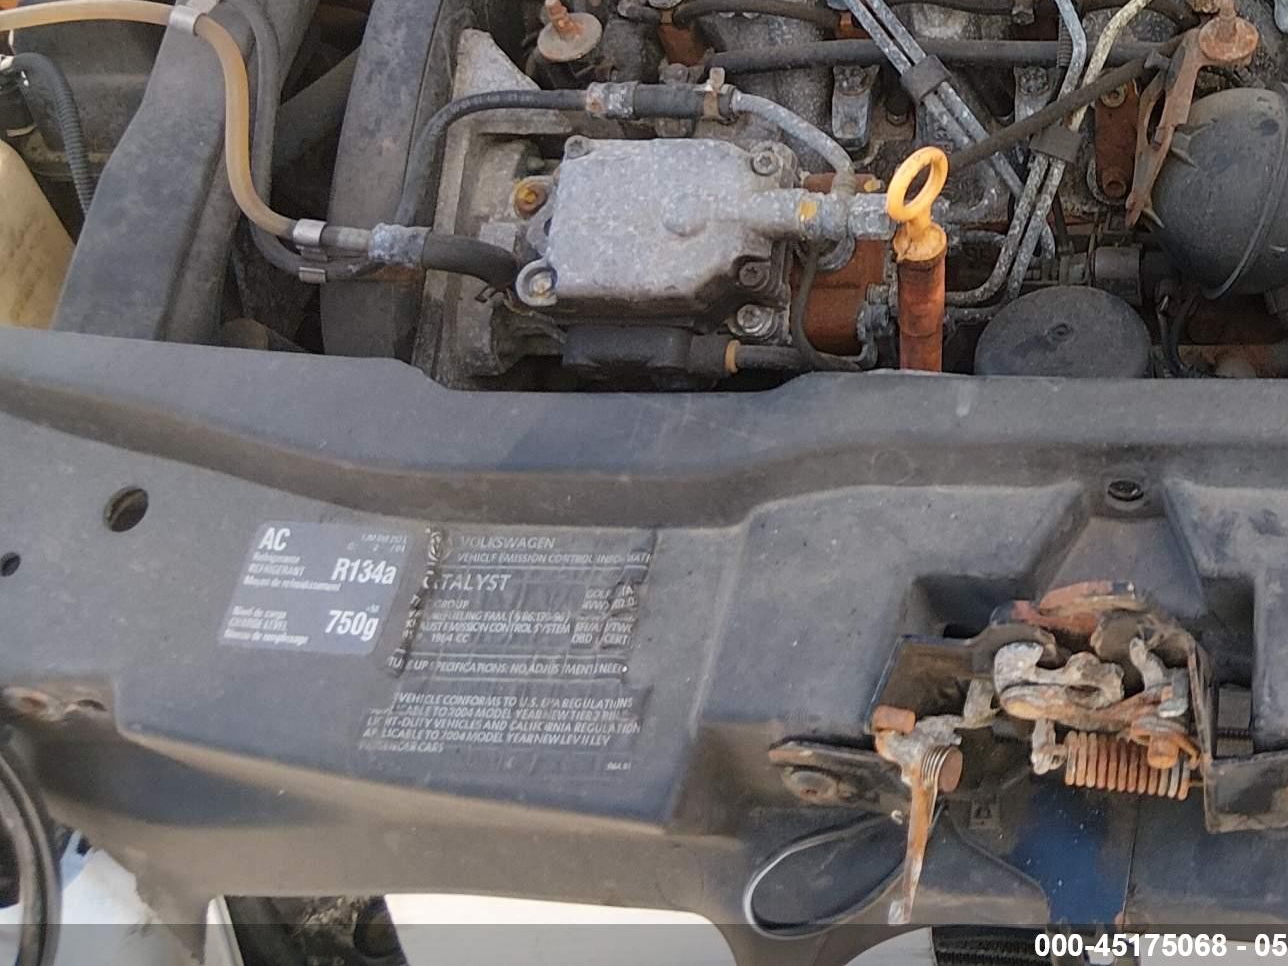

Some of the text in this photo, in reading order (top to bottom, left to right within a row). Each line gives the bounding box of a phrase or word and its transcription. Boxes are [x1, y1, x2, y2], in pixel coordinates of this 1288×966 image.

[258, 527, 291, 551] AC
[461, 536, 556, 549] VOLKSWAGEN
[330, 557, 398, 585] R134a
[325, 609, 380, 642] 750g
[398, 692, 441, 706] VEHICLE
